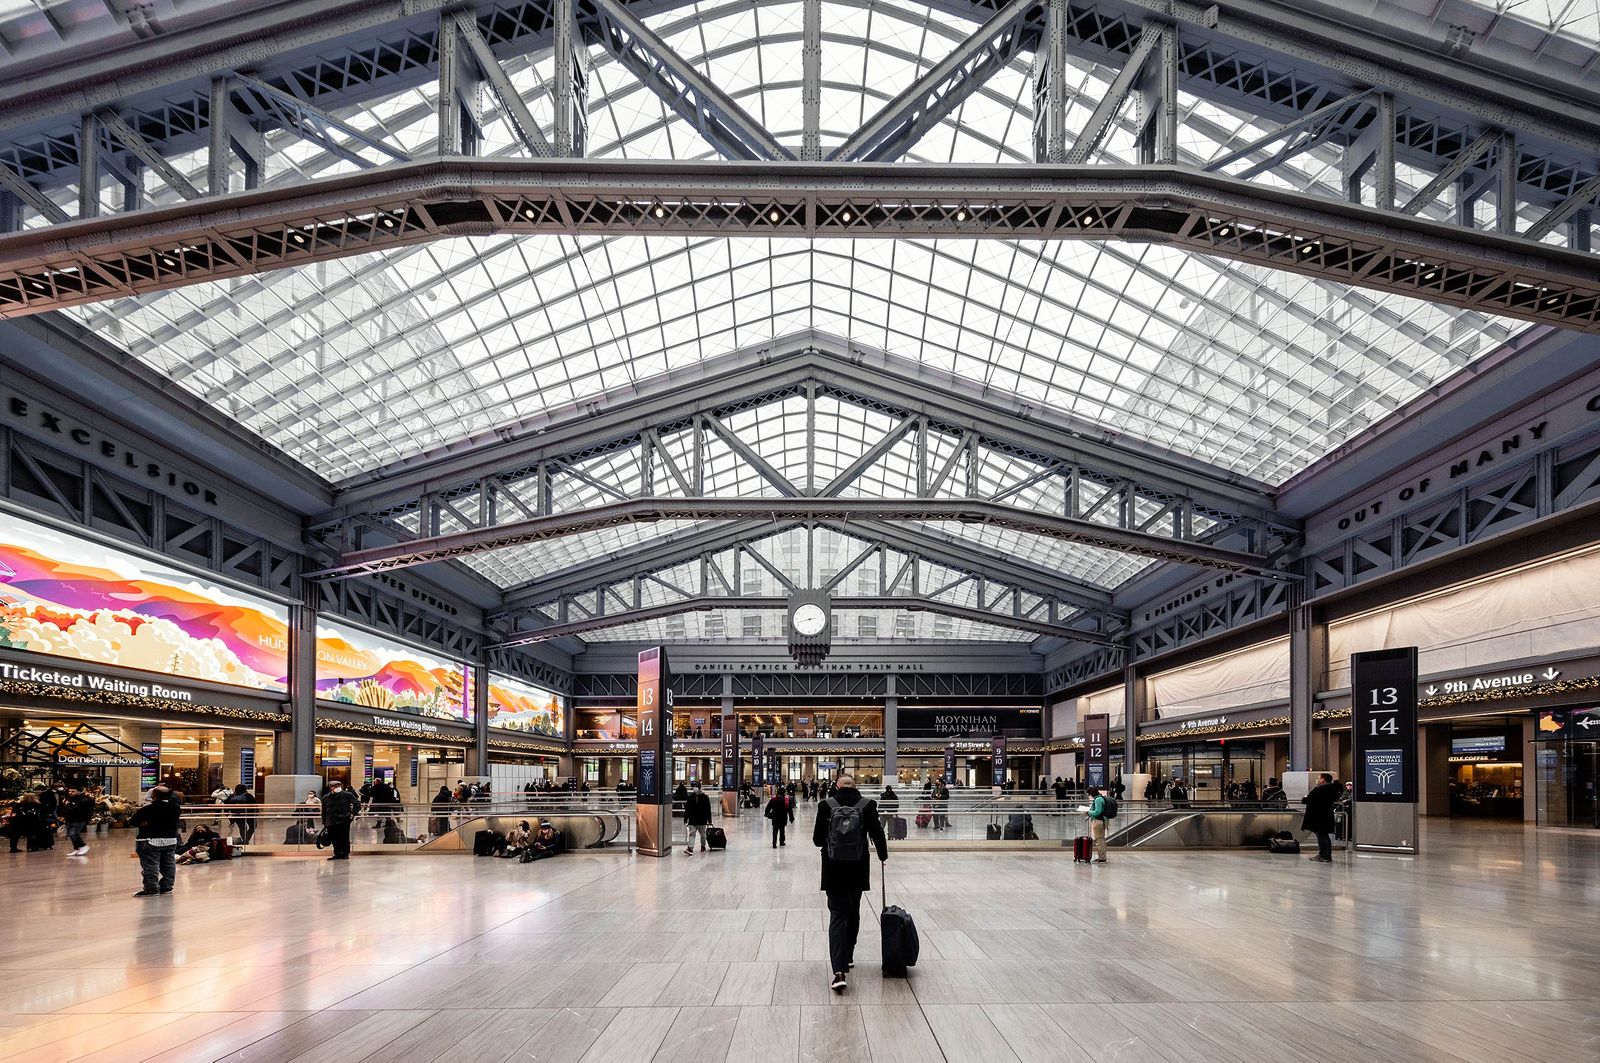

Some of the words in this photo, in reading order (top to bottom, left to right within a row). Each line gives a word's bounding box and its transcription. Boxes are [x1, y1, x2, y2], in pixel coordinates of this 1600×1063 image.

[11, 397, 218, 505] EXCELSIOR
[1338, 501, 1383, 530] OUT
[1398, 478, 1430, 500] OF
[1449, 421, 1547, 478] MANY
[372, 572, 406, 592] EVER
[412, 588, 458, 616] UPWARD
[1154, 585, 1208, 616] PLURIBUS
[336, 655, 368, 670] VALLEY
[0, 663, 83, 688] Ticketed
[88, 675, 149, 697] Waiting
[151, 684, 192, 701] Room
[1443, 681, 1467, 694] 9th
[1472, 673, 1534, 690] Avenue
[642, 688, 653, 706] 13
[1369, 687, 1398, 706] 13
[373, 716, 400, 727] Ticketed
[400, 718, 422, 732] Waiting
[422, 721, 437, 732] Room
[641, 718, 653, 737] 14
[934, 724, 968, 732] TRAIN
[970, 724, 998, 732] HALL
[935, 716, 997, 724] MOYNIHAN
[1197, 718, 1219, 727] Avenue
[1369, 717, 1399, 736] 14
[726, 734, 732, 743] 11
[1091, 733, 1101, 742] 11
[725, 749, 733, 758] 12
[1090, 748, 1102, 758] 12
